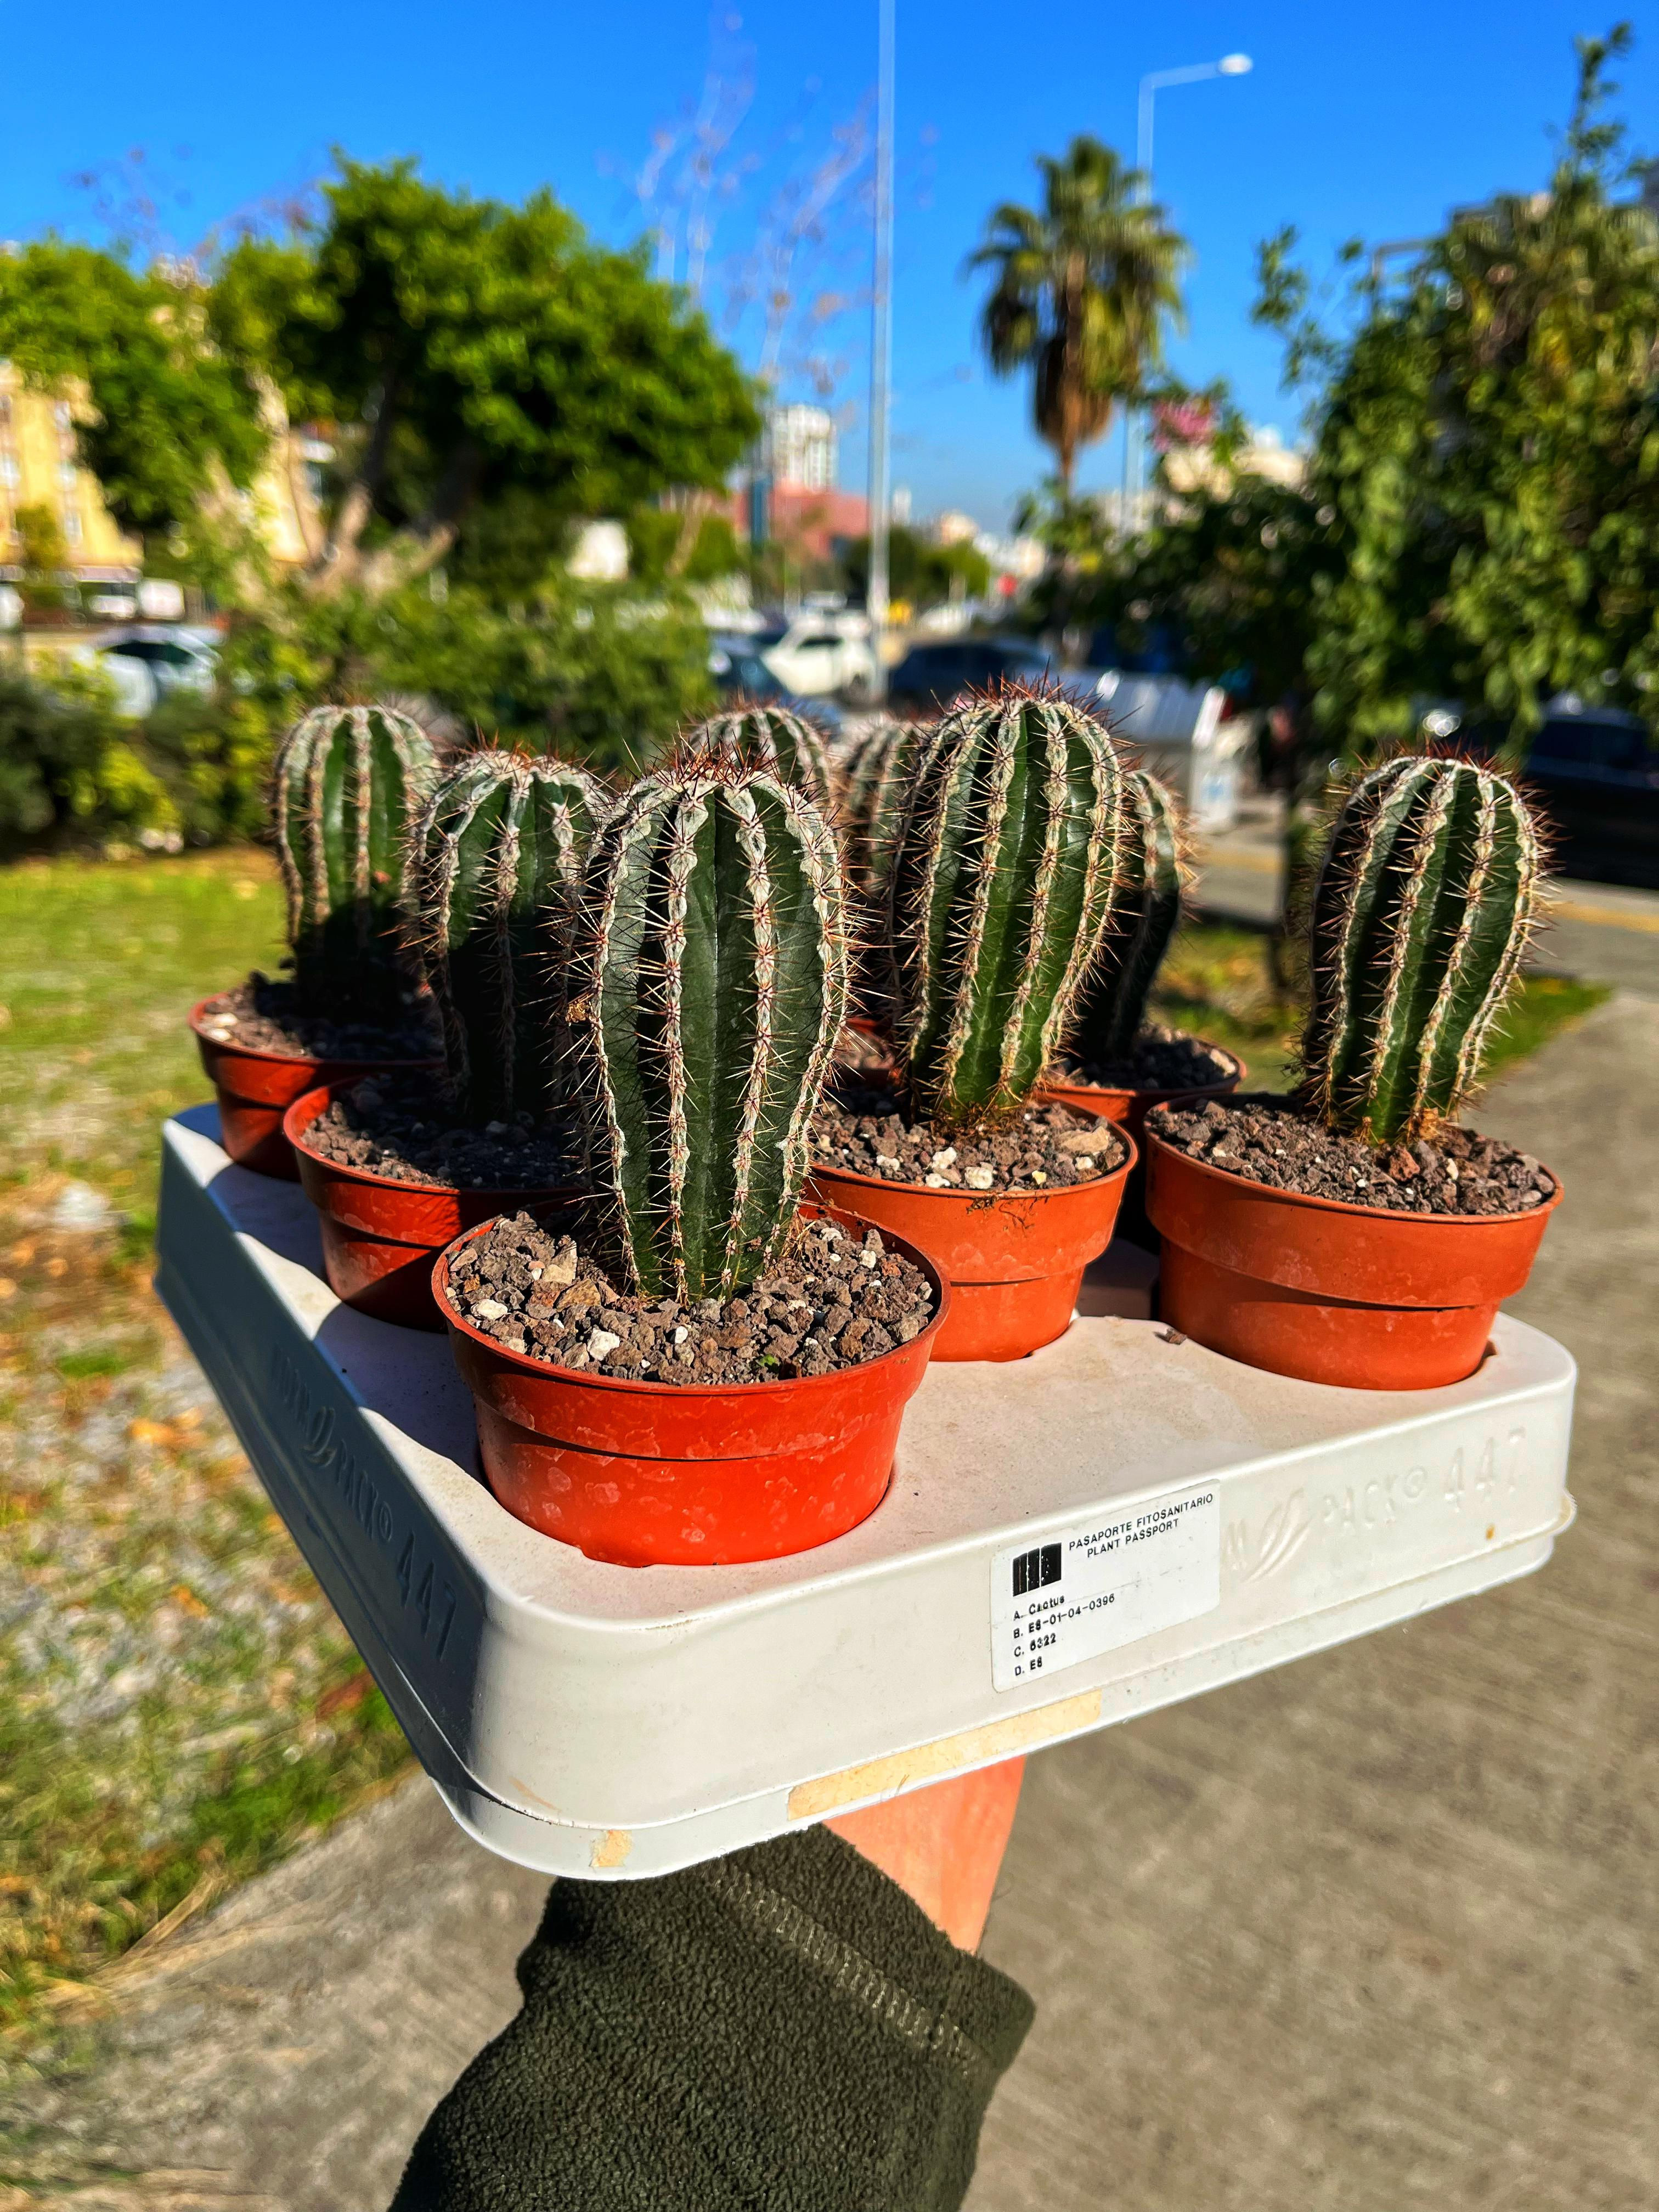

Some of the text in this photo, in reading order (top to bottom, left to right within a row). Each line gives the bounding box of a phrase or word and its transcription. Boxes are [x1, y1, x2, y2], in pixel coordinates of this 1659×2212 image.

[1444, 1426, 1526, 1513] 447
[1069, 1493, 1213, 1550] PASAPORTE FITOSANITARIO
[1087, 1518, 1179, 1558] PLANT PASSPORT
[397, 1529, 456, 1663] 447
[1013, 1610, 1023, 1621] A.
[1013, 1628, 1023, 1639] B.
[1014, 1645, 1025, 1657] C.
[1014, 1665, 1025, 1676] D.
